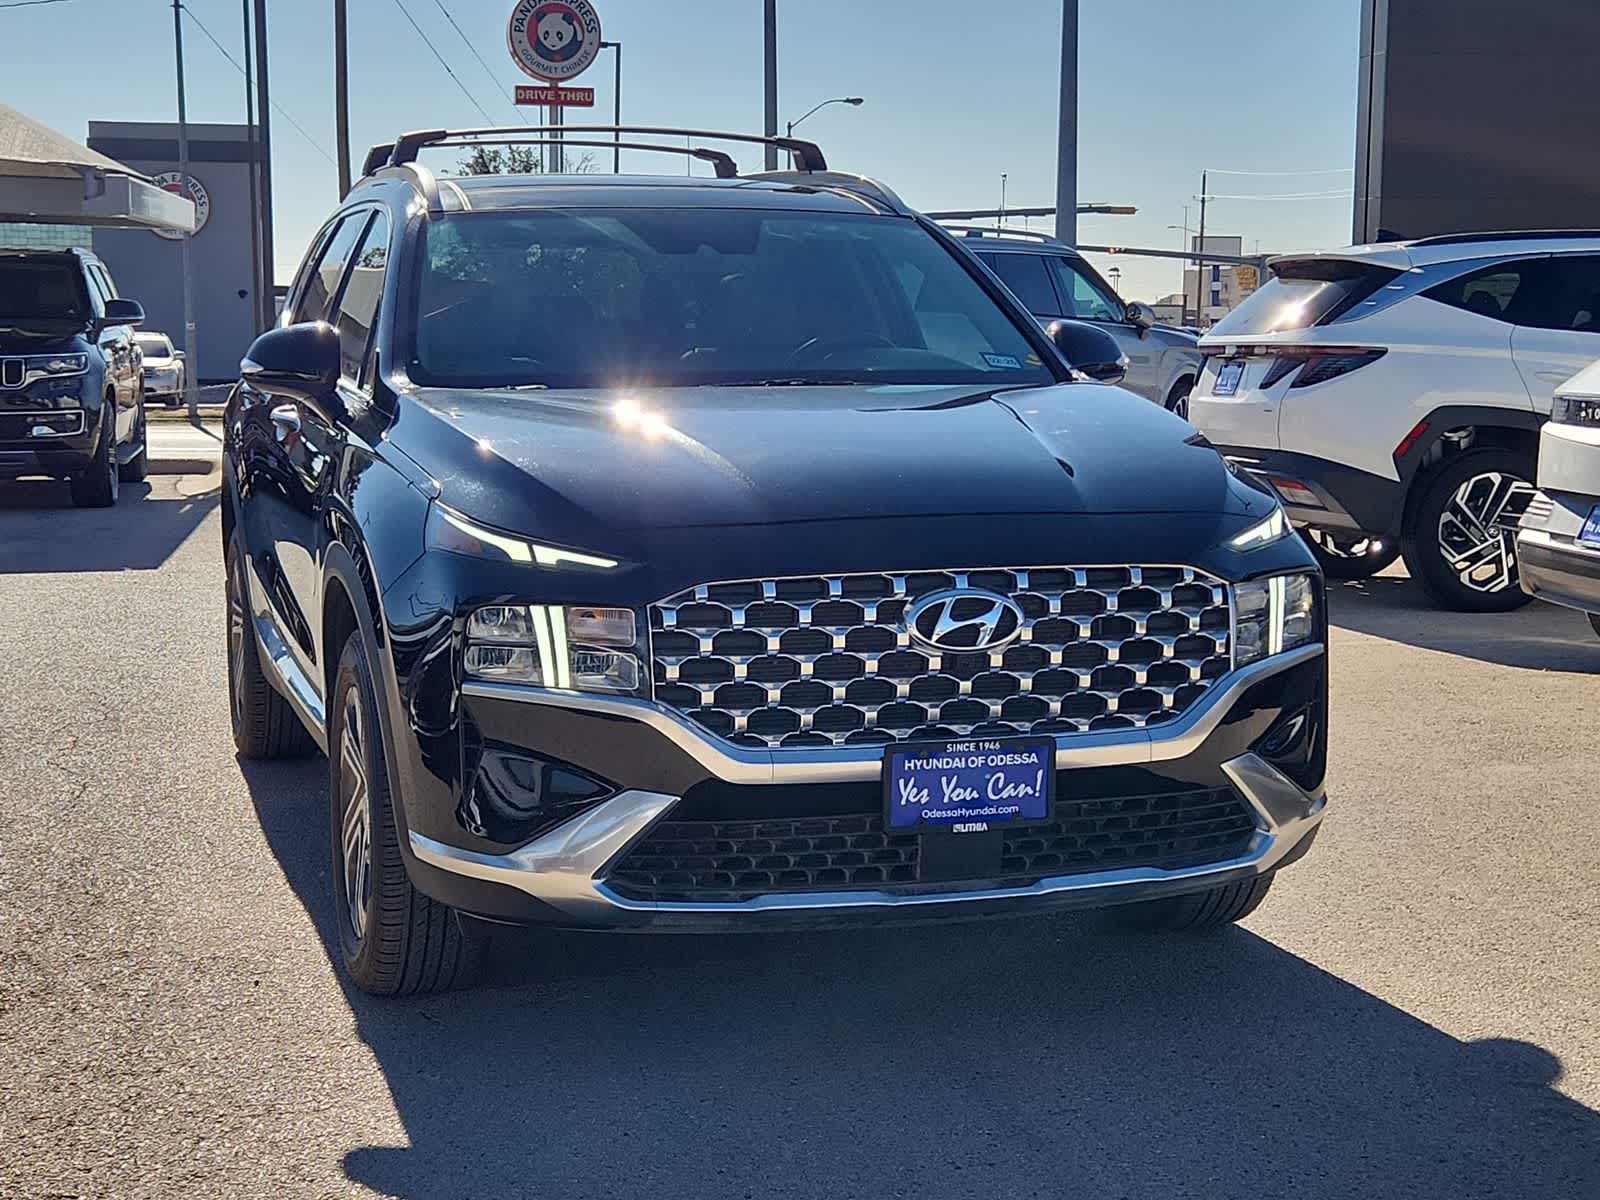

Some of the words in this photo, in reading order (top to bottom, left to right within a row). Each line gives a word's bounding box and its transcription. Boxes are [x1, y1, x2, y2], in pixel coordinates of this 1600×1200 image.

[513, 0, 548, 33] PAND
[553, 0, 597, 34] PRESS
[521, 48, 558, 74] GOURMET
[561, 49, 591, 74] CHINESE
[517, 89, 555, 100] DRIVE
[558, 91, 593, 102] THRU
[946, 743, 976, 753] SINCE
[979, 741, 1001, 751] 1946
[904, 757, 965, 771] HYUNDAI
[967, 756, 986, 768] OF
[987, 753, 1039, 767] ODESSA
[898, 776, 930, 806] Yes
[940, 774, 980, 804] You
[986, 768, 1044, 801] Can!
[921, 805, 1019, 819] OdessaHyundai.com
